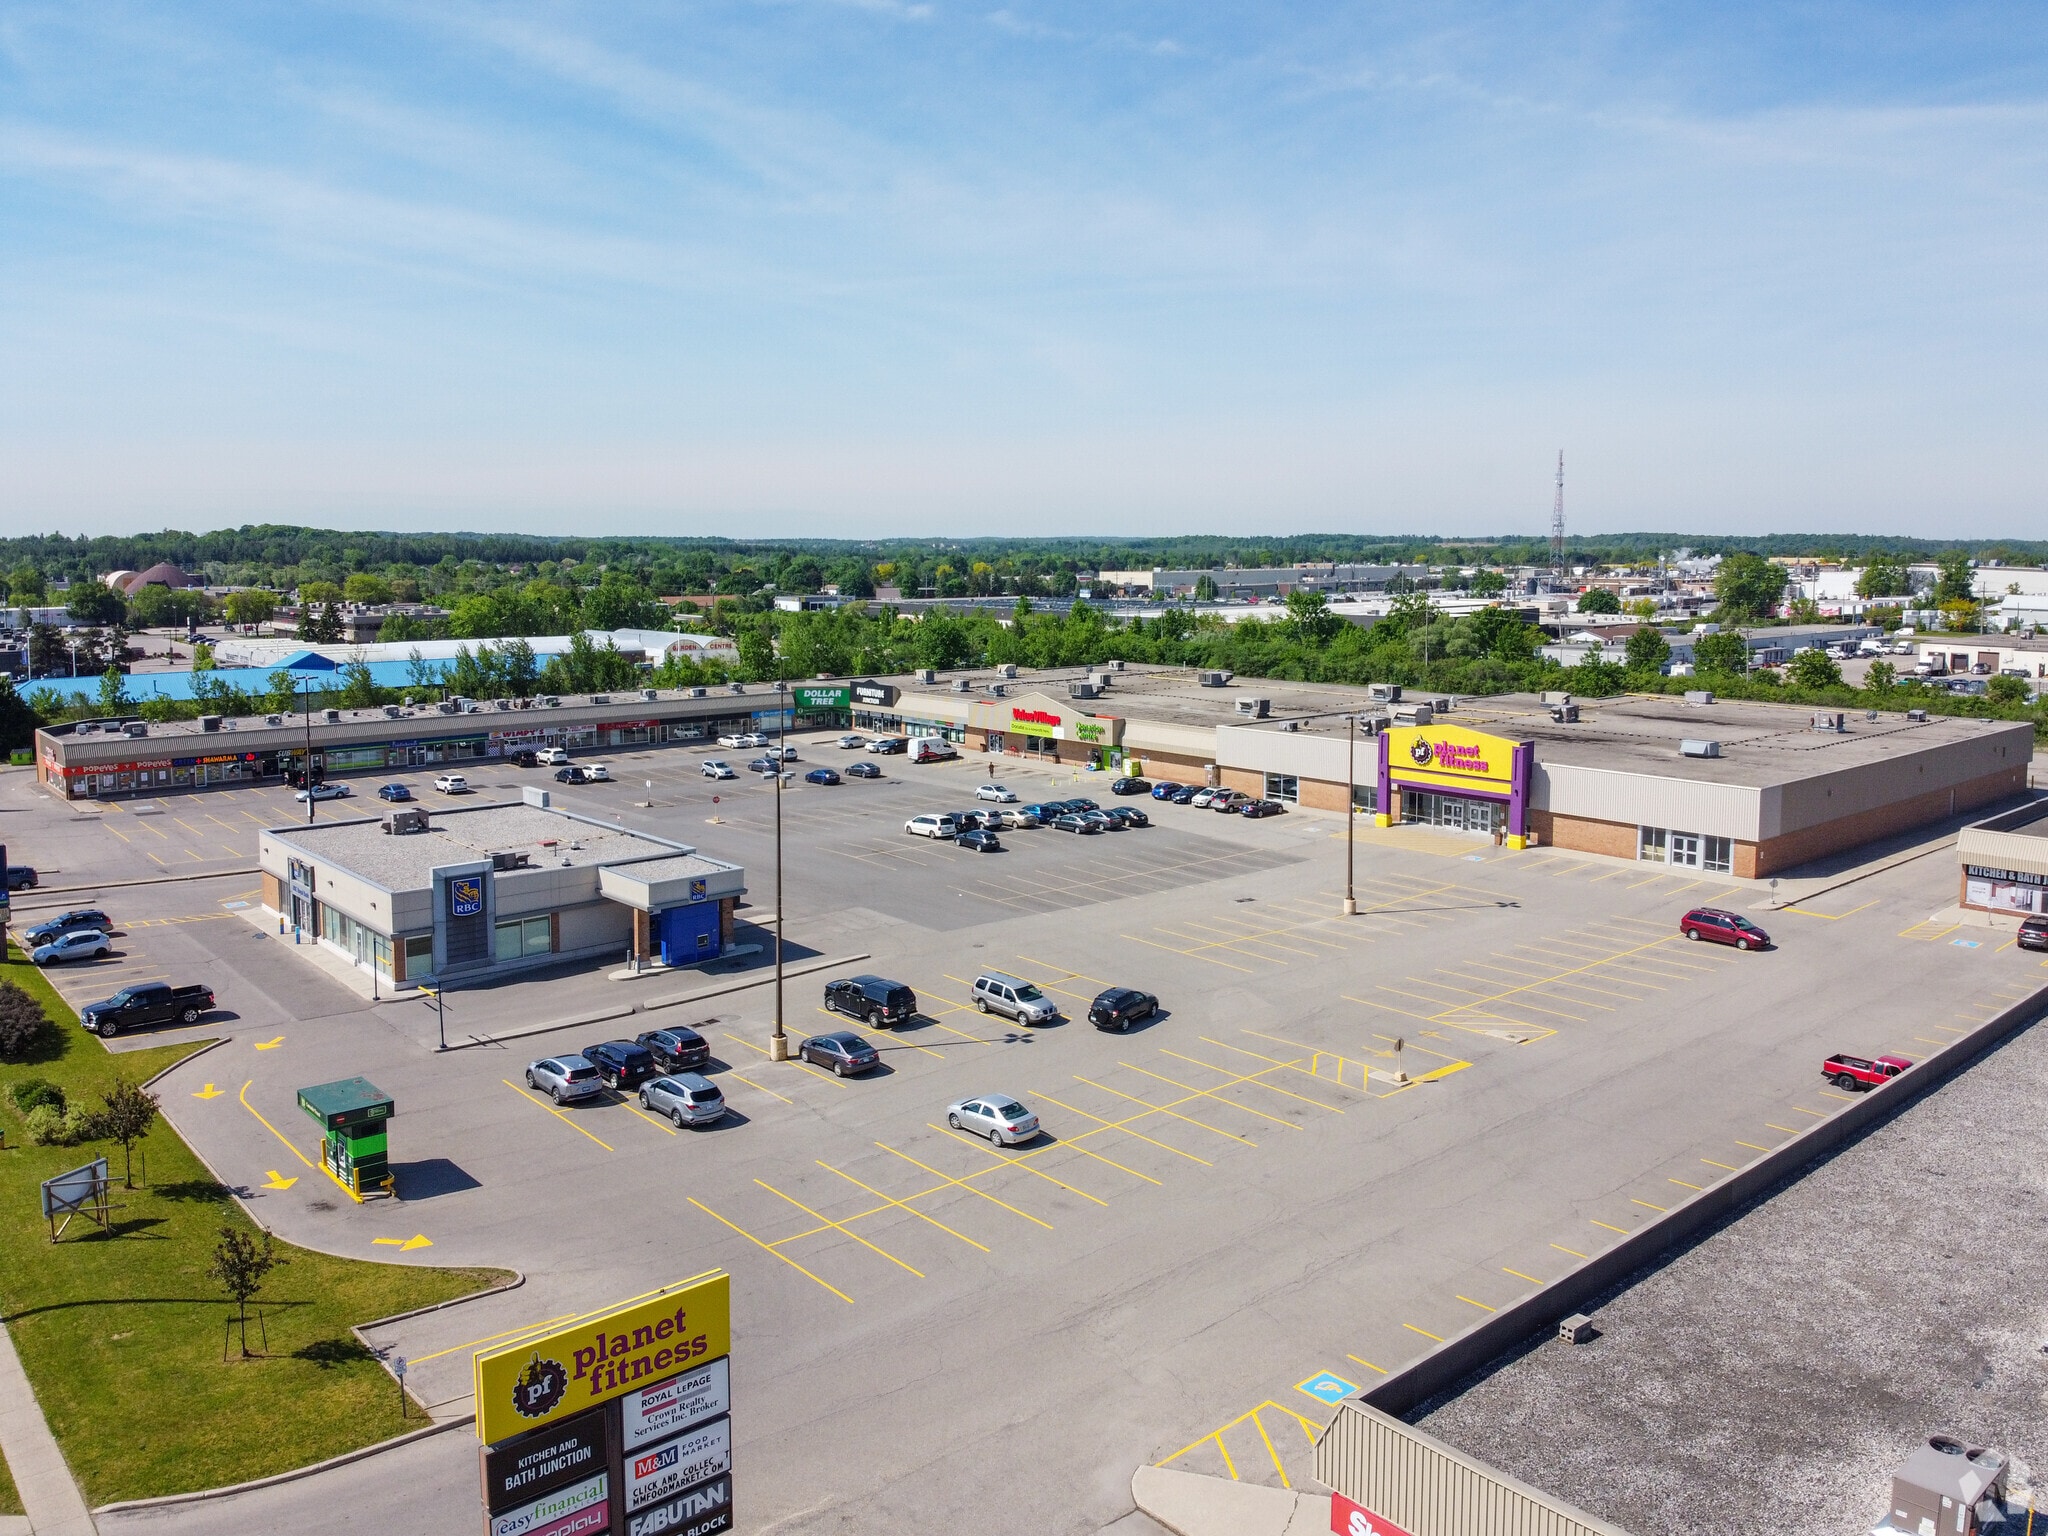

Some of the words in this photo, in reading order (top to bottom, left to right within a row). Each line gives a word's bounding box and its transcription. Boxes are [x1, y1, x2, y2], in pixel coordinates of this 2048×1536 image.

[804, 690, 842, 698] DOLLAR
[811, 698, 834, 706] TREE
[502, 728, 545, 738] WIMPY'S
[276, 748, 307, 758] SUBWAY
[1415, 747, 1425, 757] pf
[1433, 740, 1480, 757] planet
[203, 755, 238, 764] SHAWARMA
[1439, 753, 1489, 772] fitness
[1968, 865, 2007, 880] KITCHEN
[2008, 871, 2016, 880] &
[2017, 872, 2041, 884] BATH
[456, 902, 479, 913] RBC
[573, 1306, 687, 1380] planet
[590, 1334, 708, 1396] fitness
[527, 1374, 552, 1405] pf
[641, 1390, 673, 1408] ROYAL
[634, 1420, 669, 1438] Services
[671, 1412, 688, 1423] Inc.
[689, 1399, 719, 1416] Broker
[647, 1409, 677, 1424] Crown
[679, 1395, 706, 1412] Realty
[682, 1435, 708, 1451] FOOD
[682, 1436, 721, 1457] MARKET
[518, 1445, 557, 1469] KITCHEN
[559, 1438, 578, 1452] AND
[637, 1449, 676, 1476] M&M
[505, 1467, 536, 1491] BATH
[538, 1446, 592, 1478] JUNCTION
[633, 1481, 658, 1497] CLICK
[662, 1472, 678, 1486] AND
[687, 1513, 727, 1536] BLOCK
